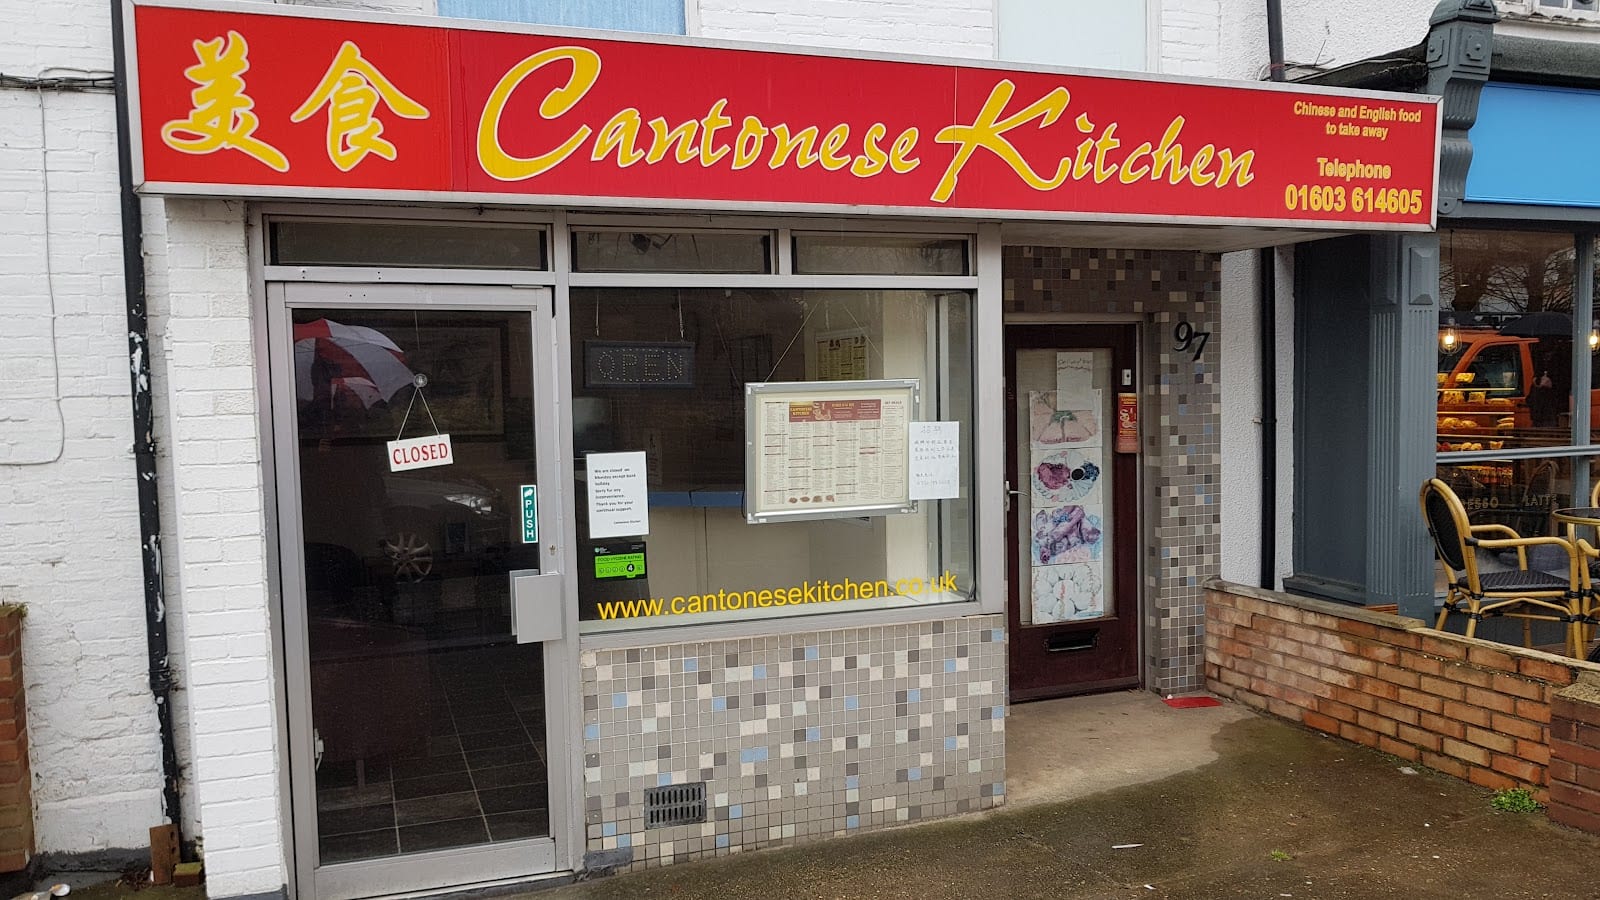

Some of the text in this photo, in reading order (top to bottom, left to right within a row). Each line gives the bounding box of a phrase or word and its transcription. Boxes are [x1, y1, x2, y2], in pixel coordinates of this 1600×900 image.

[160, 30, 431, 173] 美食
[1293, 101, 1422, 123] Chinese and English food
[476, 45, 1256, 204] Cantonese Kitchen
[1325, 122, 1389, 141] to take away
[1316, 158, 1392, 182] Telephone
[1285, 184, 1423, 215] 01603 614605
[1173, 321, 1210, 361] 97
[598, 352, 684, 378] OPEN
[393, 443, 448, 465] CLOSED
[525, 500, 535, 538] PUSH
[597, 570, 958, 620] www.cantonesekitchen.co.uk
